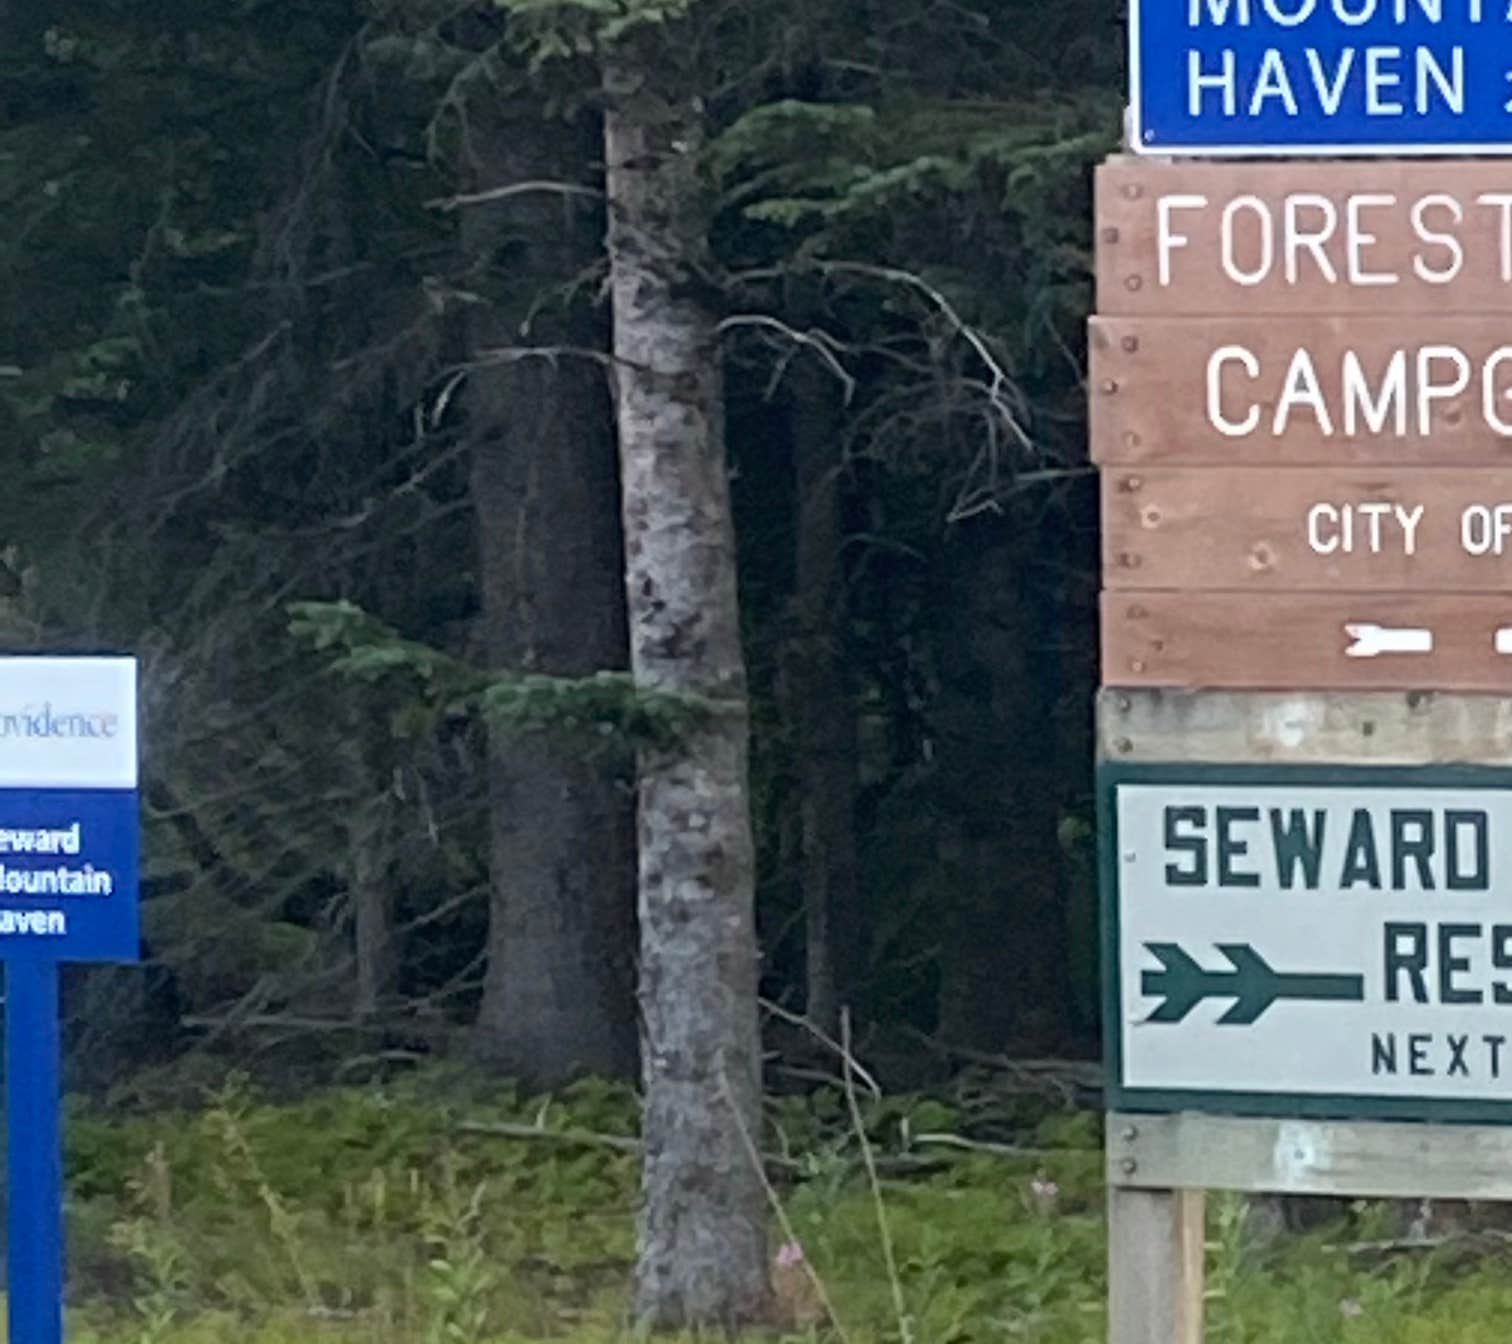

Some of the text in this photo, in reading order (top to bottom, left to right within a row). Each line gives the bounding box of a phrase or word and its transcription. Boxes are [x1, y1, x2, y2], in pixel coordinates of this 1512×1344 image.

[1187, 45, 1465, 117] HAVEN
[1307, 502, 1425, 556] CITY
[0, 702, 117, 737] vidence
[1162, 804, 1491, 892] SEWARD
[0, 864, 112, 895] ountain
[1370, 1031, 1507, 1080] NEXT
